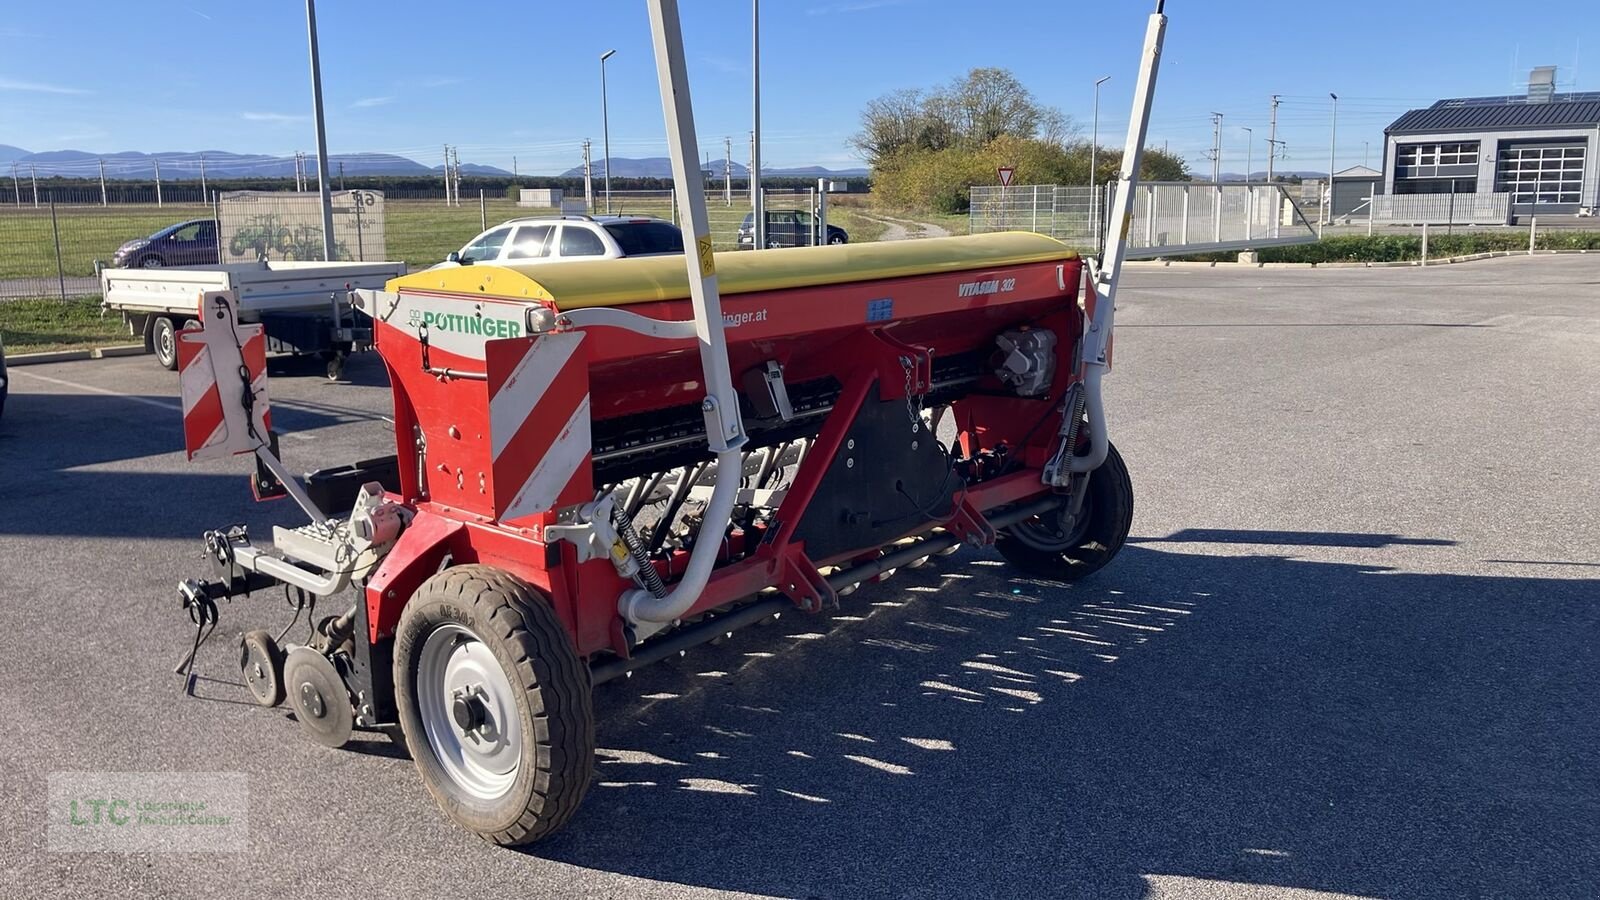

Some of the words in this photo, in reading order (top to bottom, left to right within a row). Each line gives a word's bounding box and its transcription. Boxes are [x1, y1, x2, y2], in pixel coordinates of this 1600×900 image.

[959, 280, 999, 297] VITASEM
[1001, 278, 1016, 292] 302
[722, 309, 768, 327] inger.at
